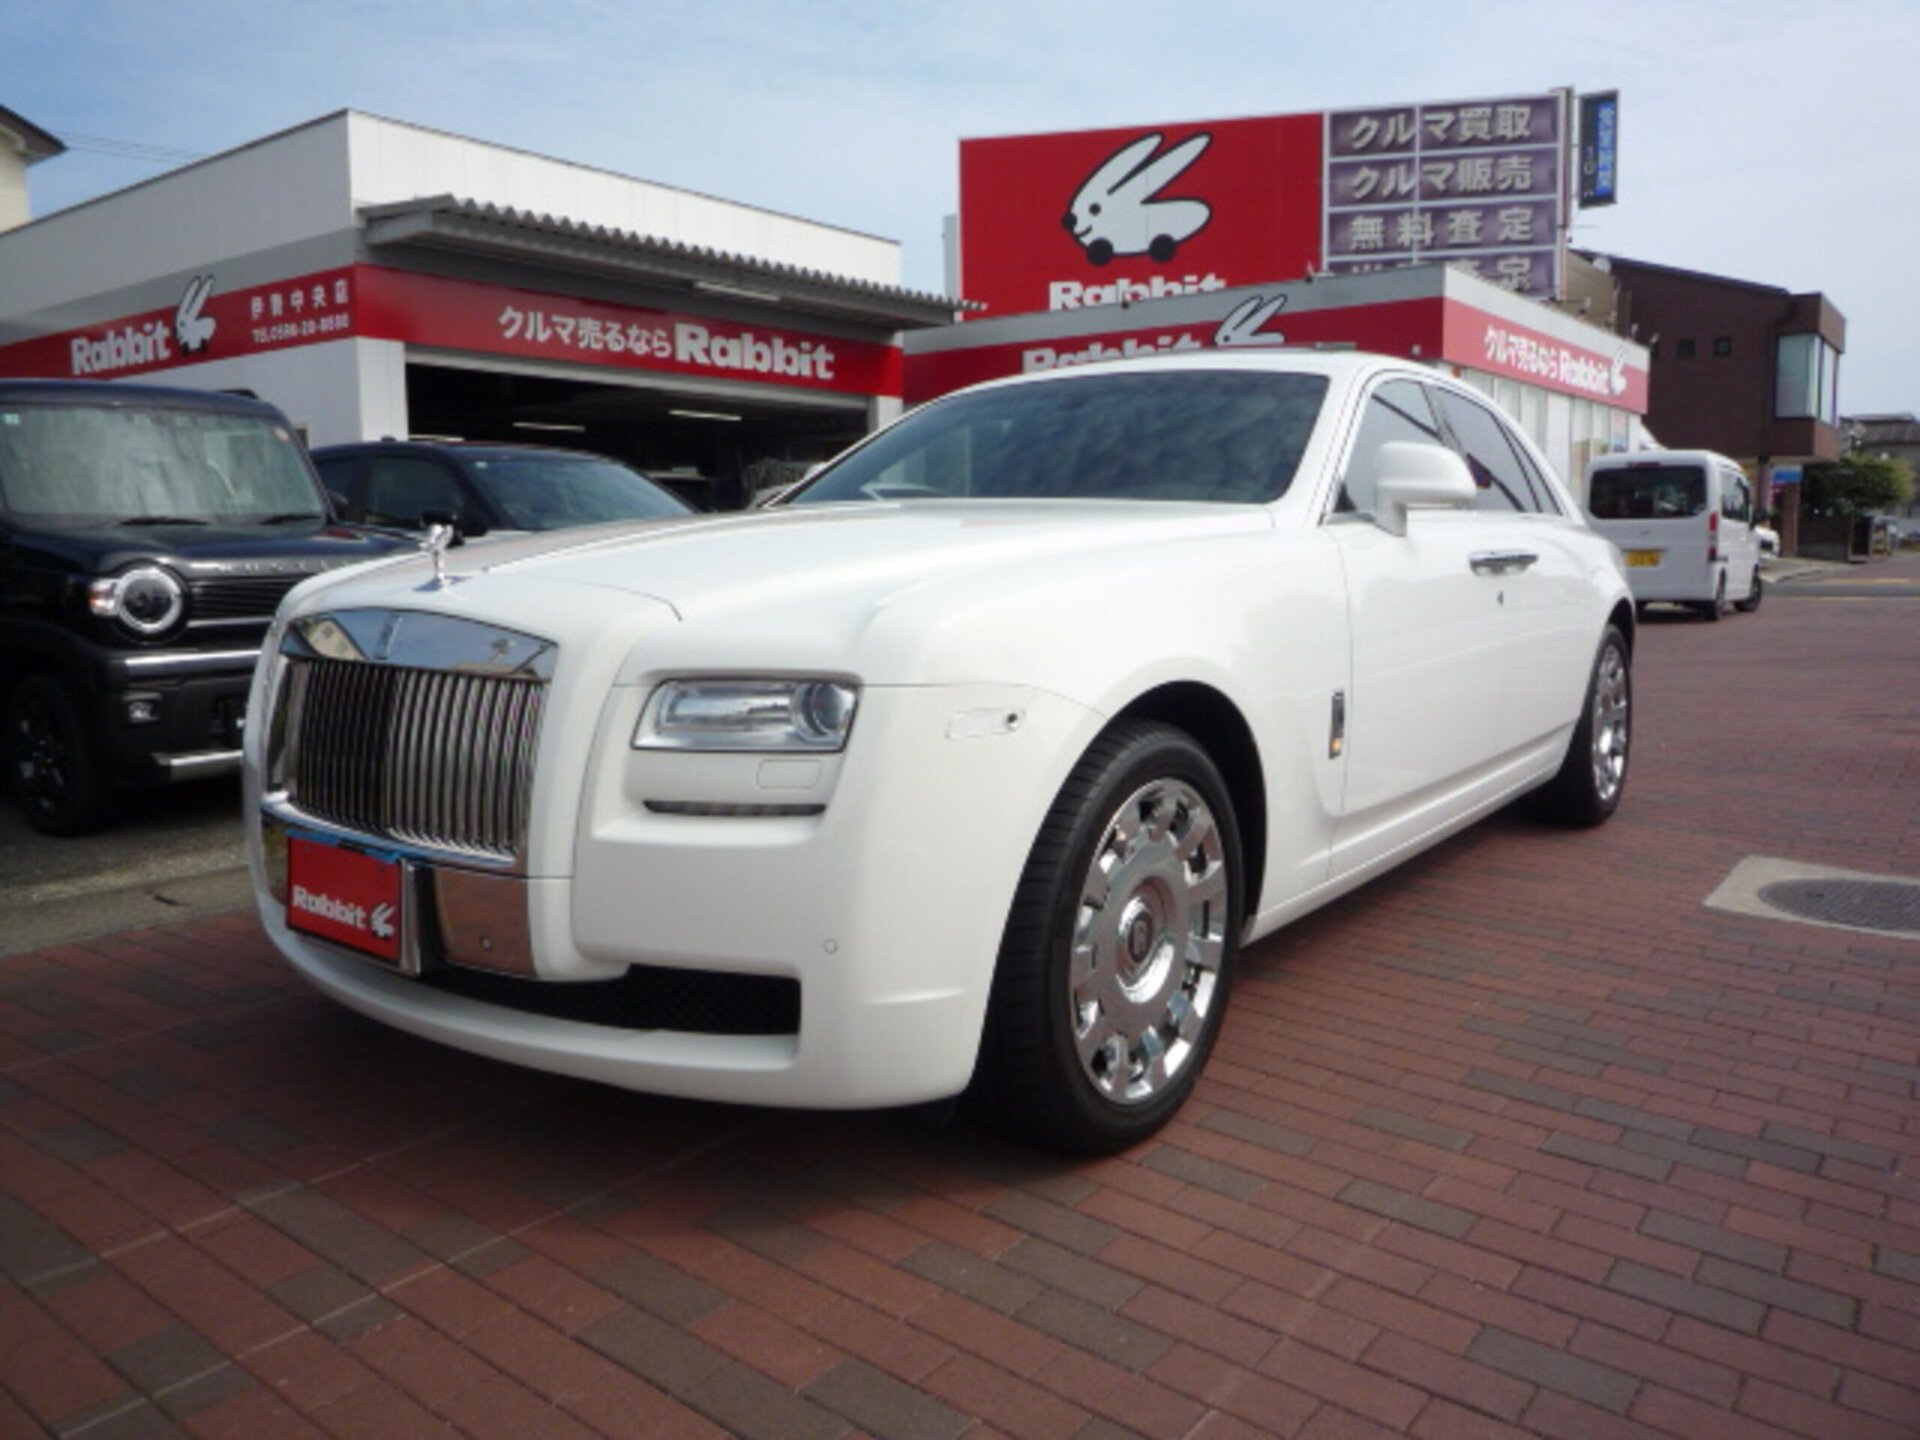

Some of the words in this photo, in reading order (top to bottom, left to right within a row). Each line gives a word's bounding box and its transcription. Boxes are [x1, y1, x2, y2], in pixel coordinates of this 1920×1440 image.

[1351, 104, 1531, 149] クルマ買取
[1351, 155, 1533, 199] クルマ販売
[1351, 206, 1533, 250] 無料査定
[71, 320, 171, 376] Rabbit
[498, 305, 672, 359] クルマ売るなら
[674, 322, 834, 380] Rabbit
[1559, 349, 1609, 395] Rabbit
[293, 885, 367, 931] Rabbit
